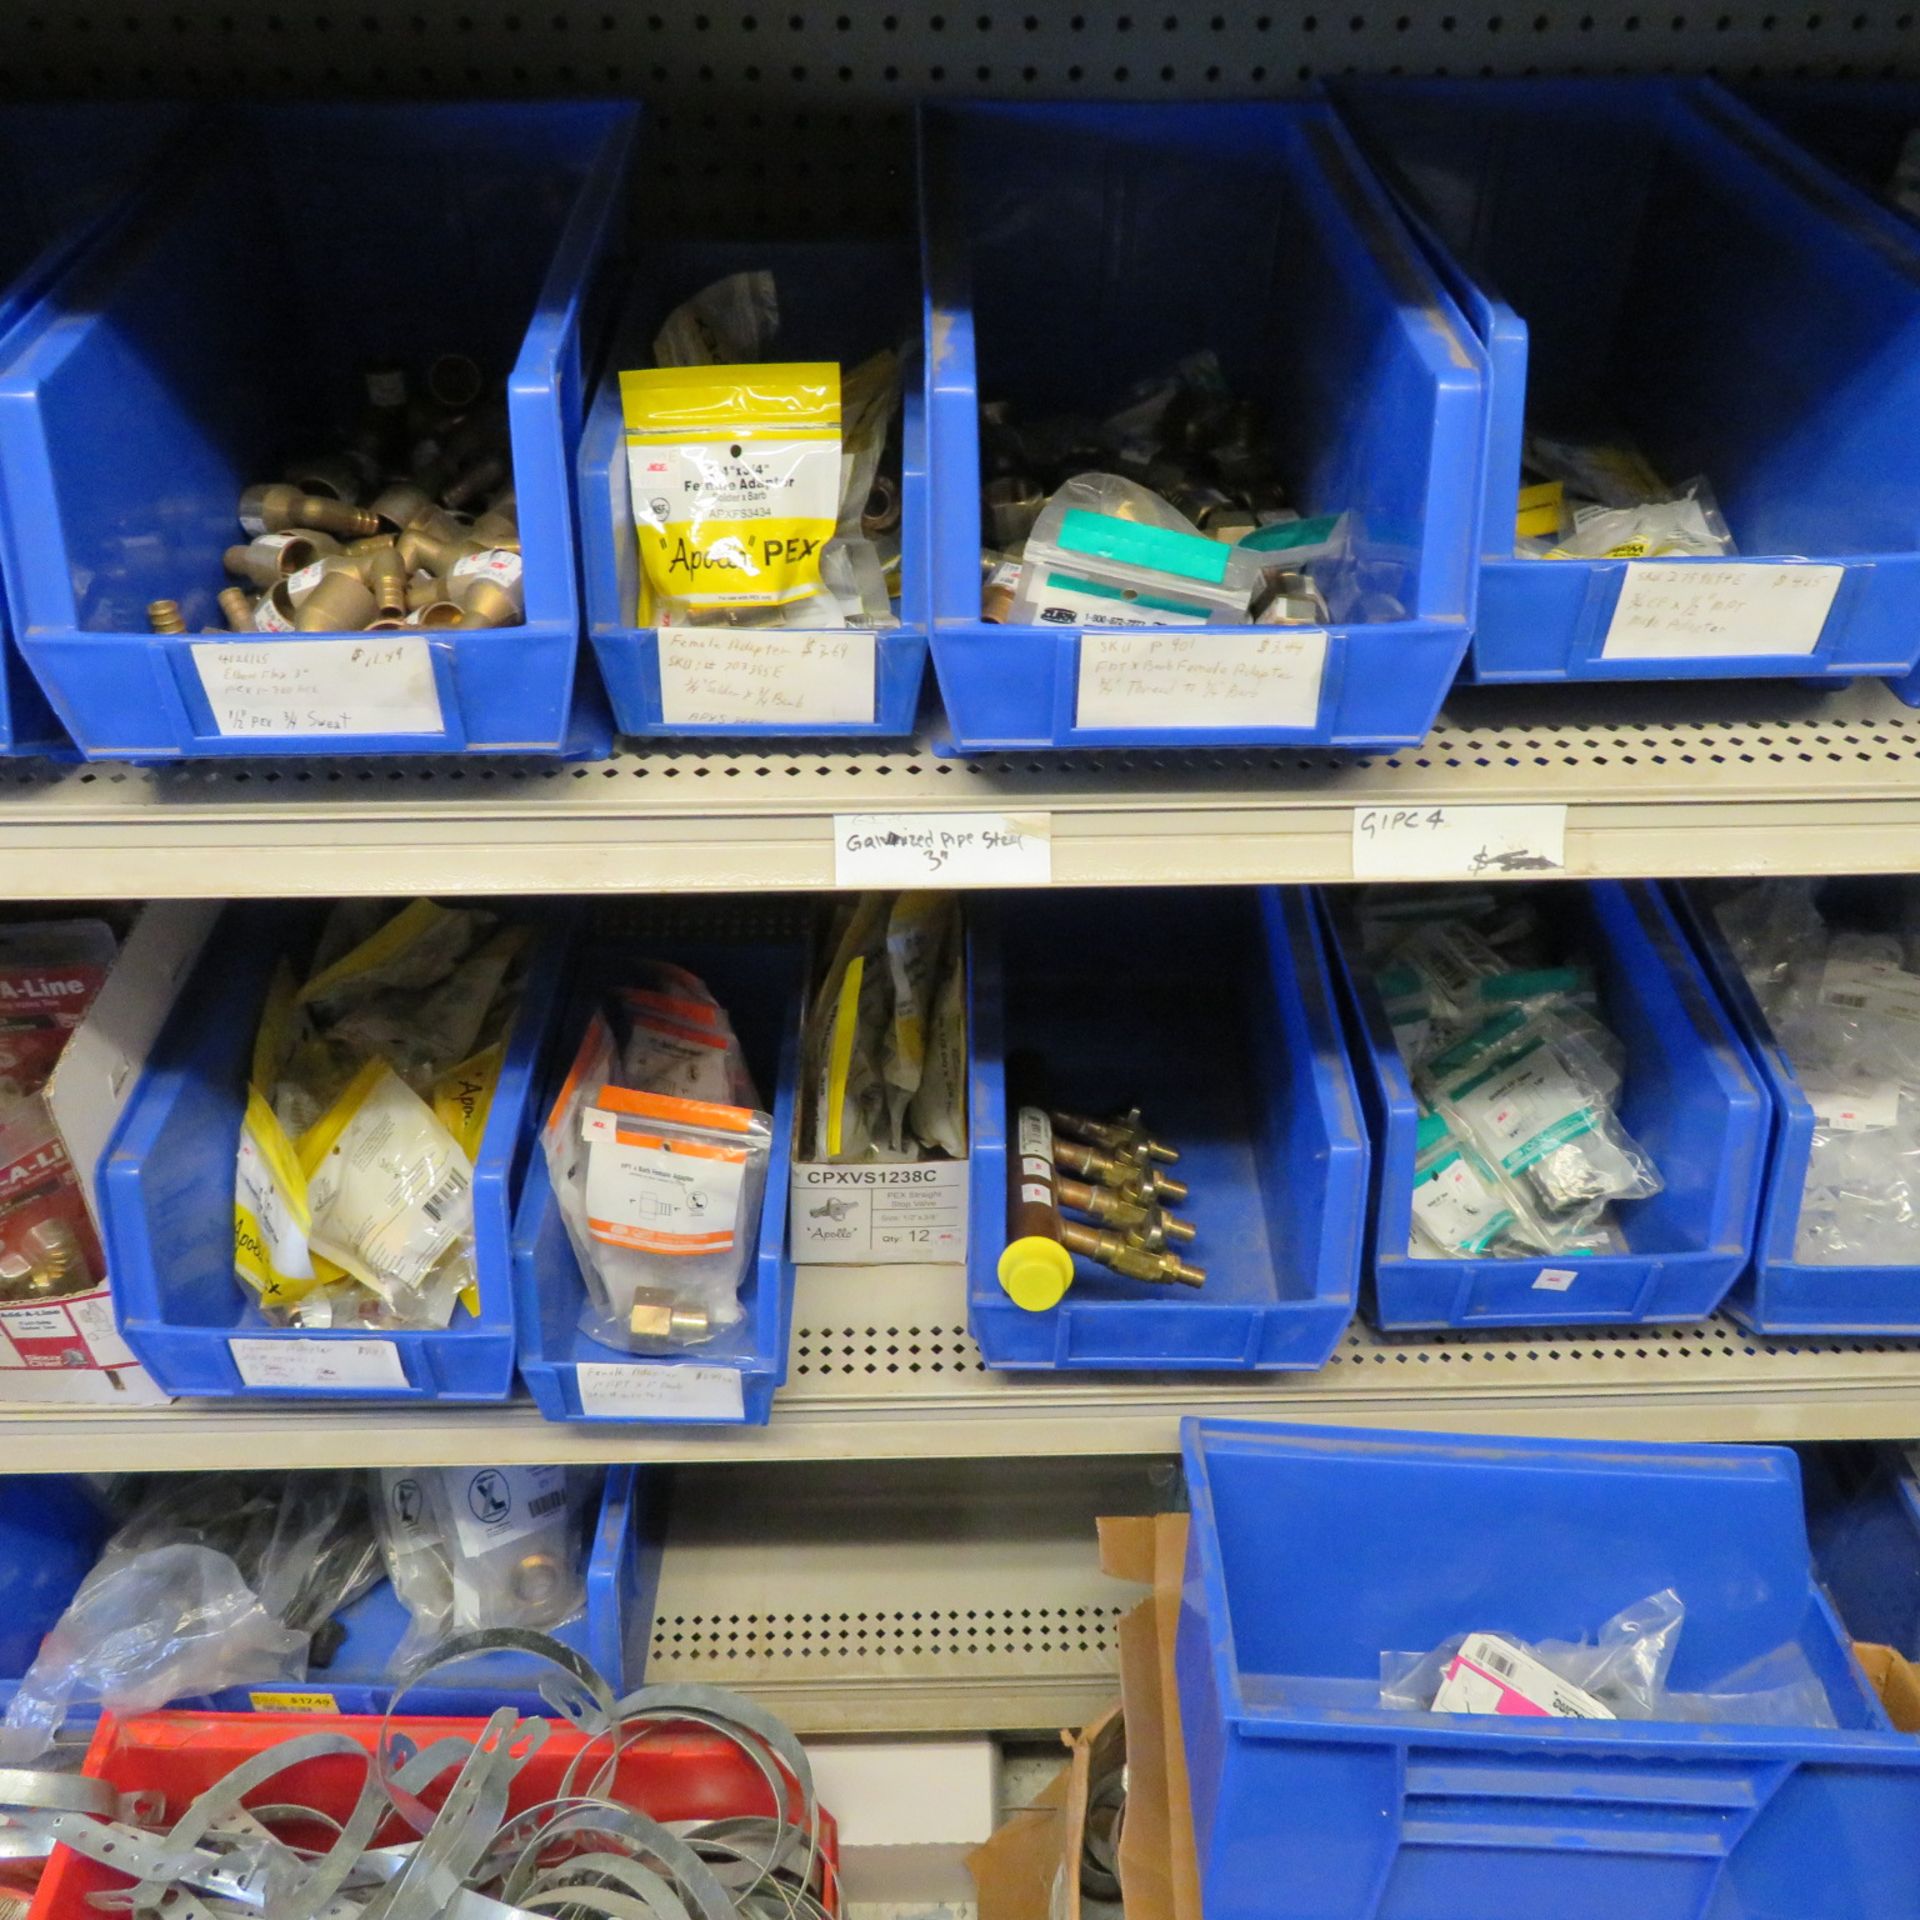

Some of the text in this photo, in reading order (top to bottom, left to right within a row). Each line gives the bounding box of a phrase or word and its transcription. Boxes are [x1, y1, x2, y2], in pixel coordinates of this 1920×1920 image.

[684, 478, 794, 492] Feme Adaptr
[764, 538, 820, 566] PEX
[923, 850, 948, 872] 3"
[807, 1169, 937, 1184] CPXVS1238C
[908, 1229, 930, 1243] 12
